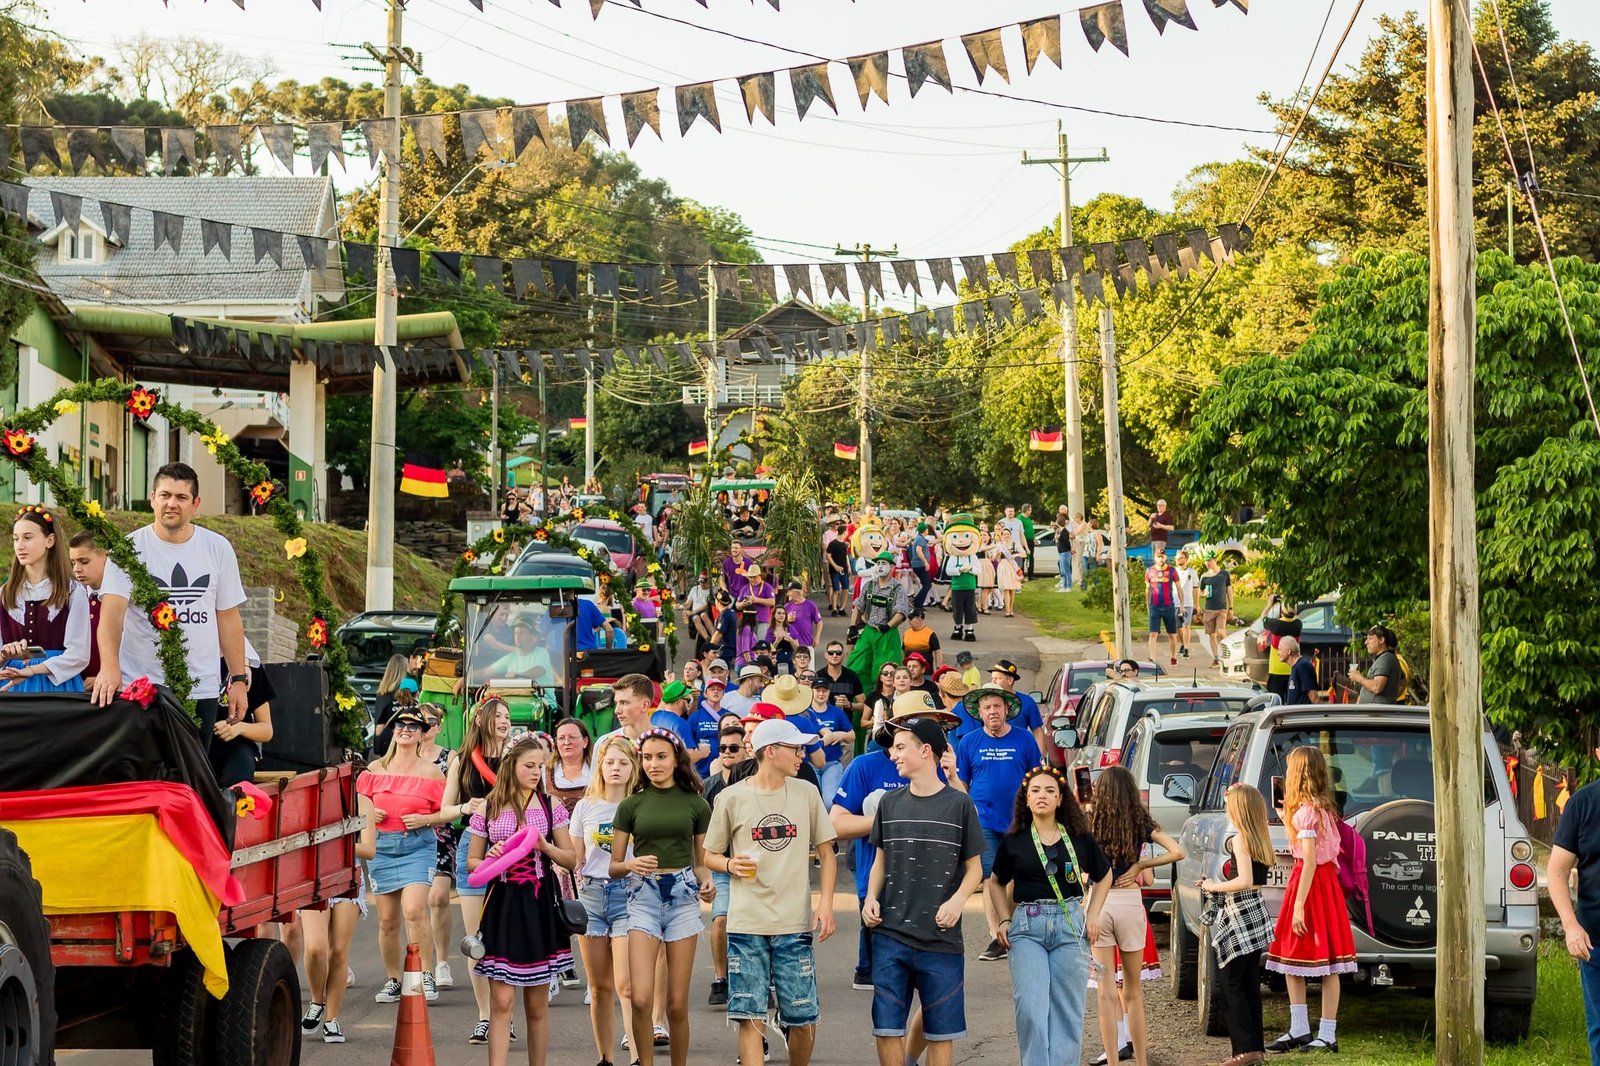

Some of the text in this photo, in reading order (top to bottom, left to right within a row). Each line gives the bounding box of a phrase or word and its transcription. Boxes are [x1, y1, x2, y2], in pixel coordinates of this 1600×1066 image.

[174, 607, 208, 624] das
[1381, 882, 1395, 891] The
[1396, 883, 1411, 891] car,
[1412, 883, 1423, 891] the
